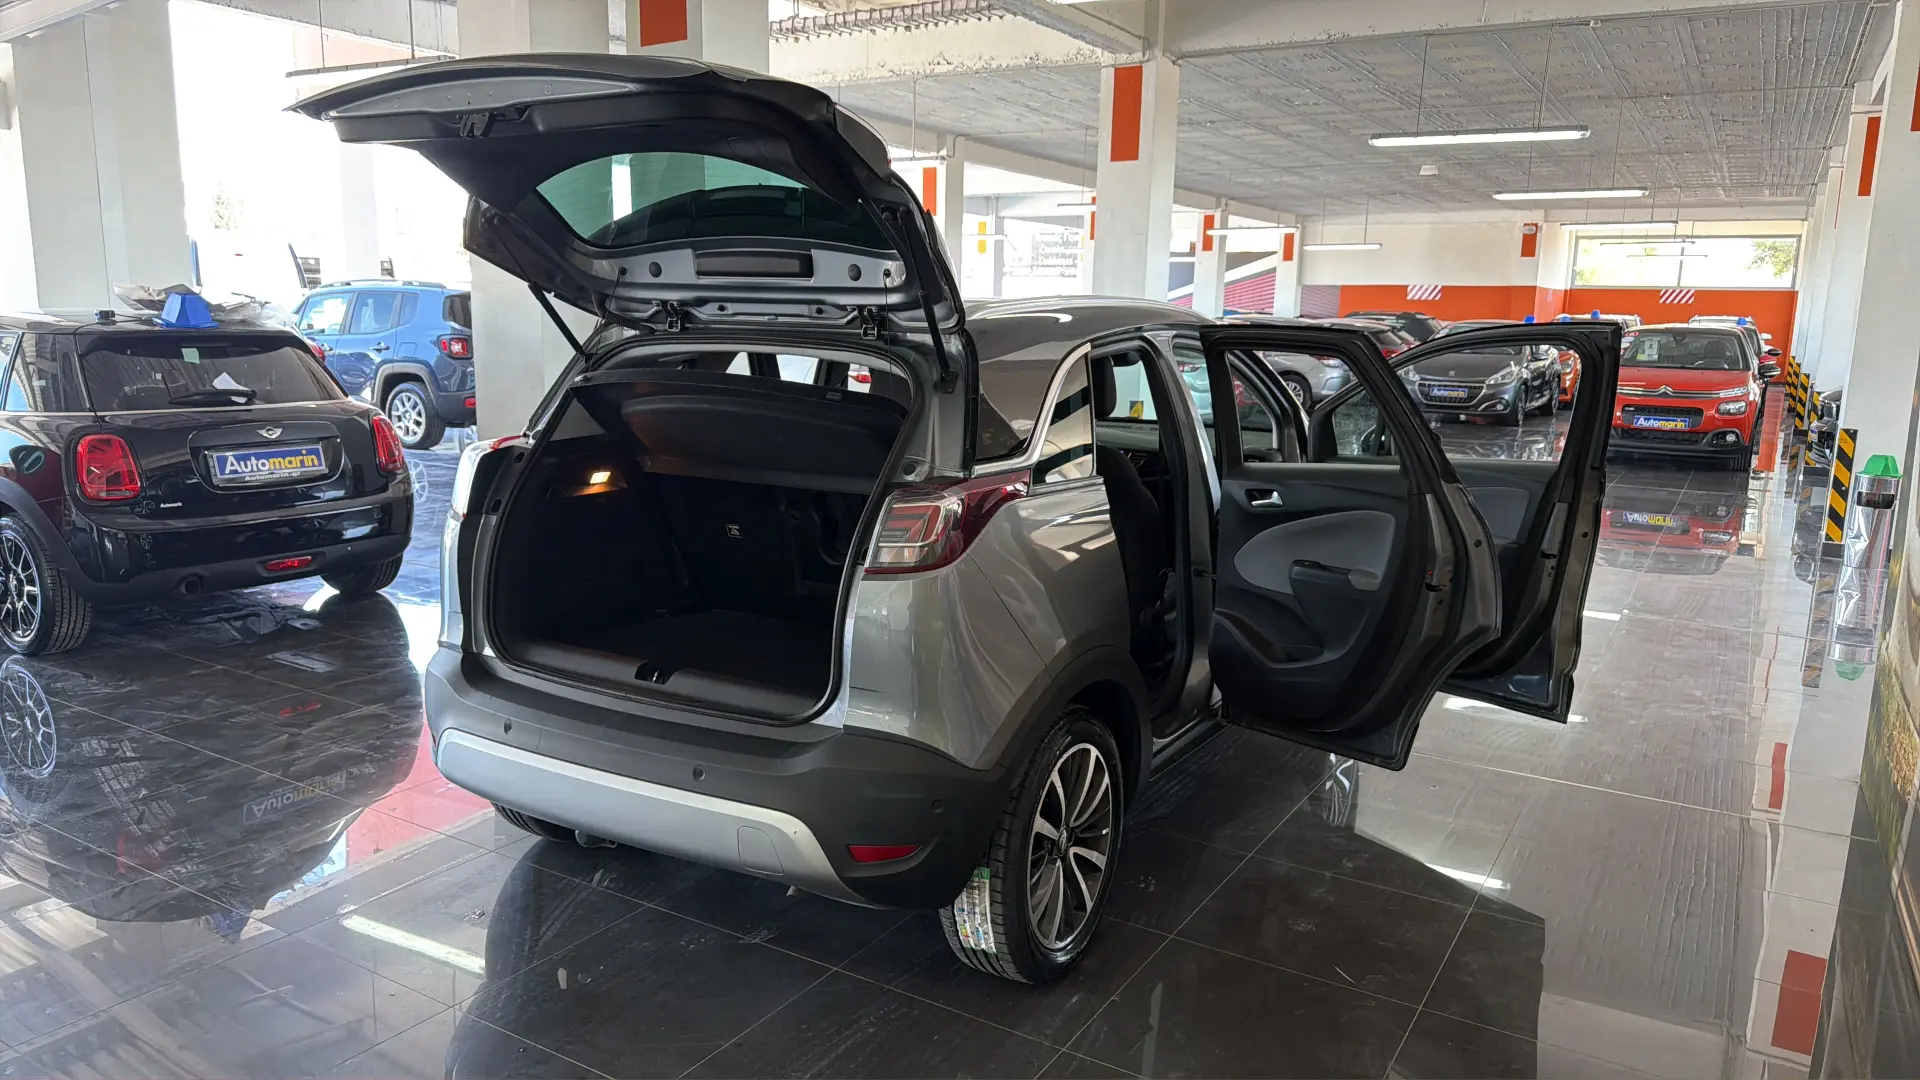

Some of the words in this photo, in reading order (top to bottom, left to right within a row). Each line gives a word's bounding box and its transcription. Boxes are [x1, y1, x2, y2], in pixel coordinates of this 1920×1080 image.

[1432, 388, 1465, 397] Automarin
[1637, 417, 1685, 428] Automarin
[225, 449, 319, 474] Automarin
[245, 471, 301, 481] Automarin.gr
